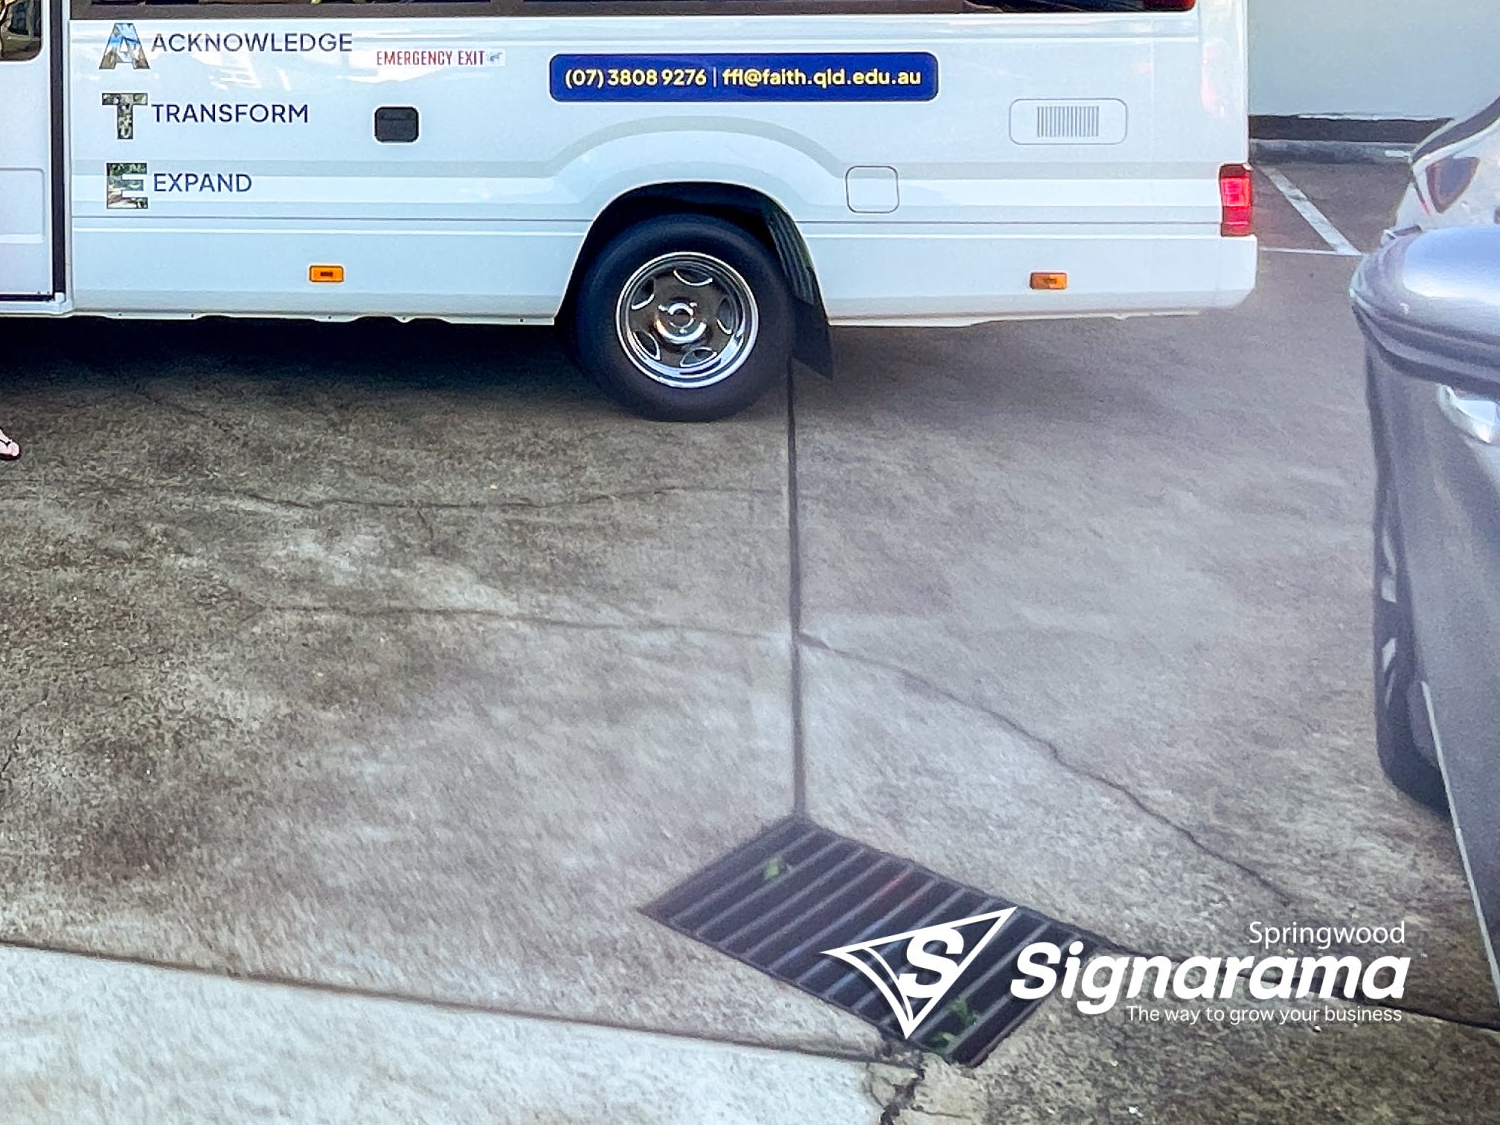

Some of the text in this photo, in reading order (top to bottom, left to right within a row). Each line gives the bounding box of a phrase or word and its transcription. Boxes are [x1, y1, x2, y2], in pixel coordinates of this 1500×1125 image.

[151, 31, 354, 55] ACKNOWLEDGE
[376, 50, 485, 66] EMERGENCY EXIT
[564, 67, 922, 91] (07) 3808 9276 ffl@faith.qld.edu.au
[151, 102, 309, 124] TRANSFORM
[153, 172, 253, 193] EXPAND
